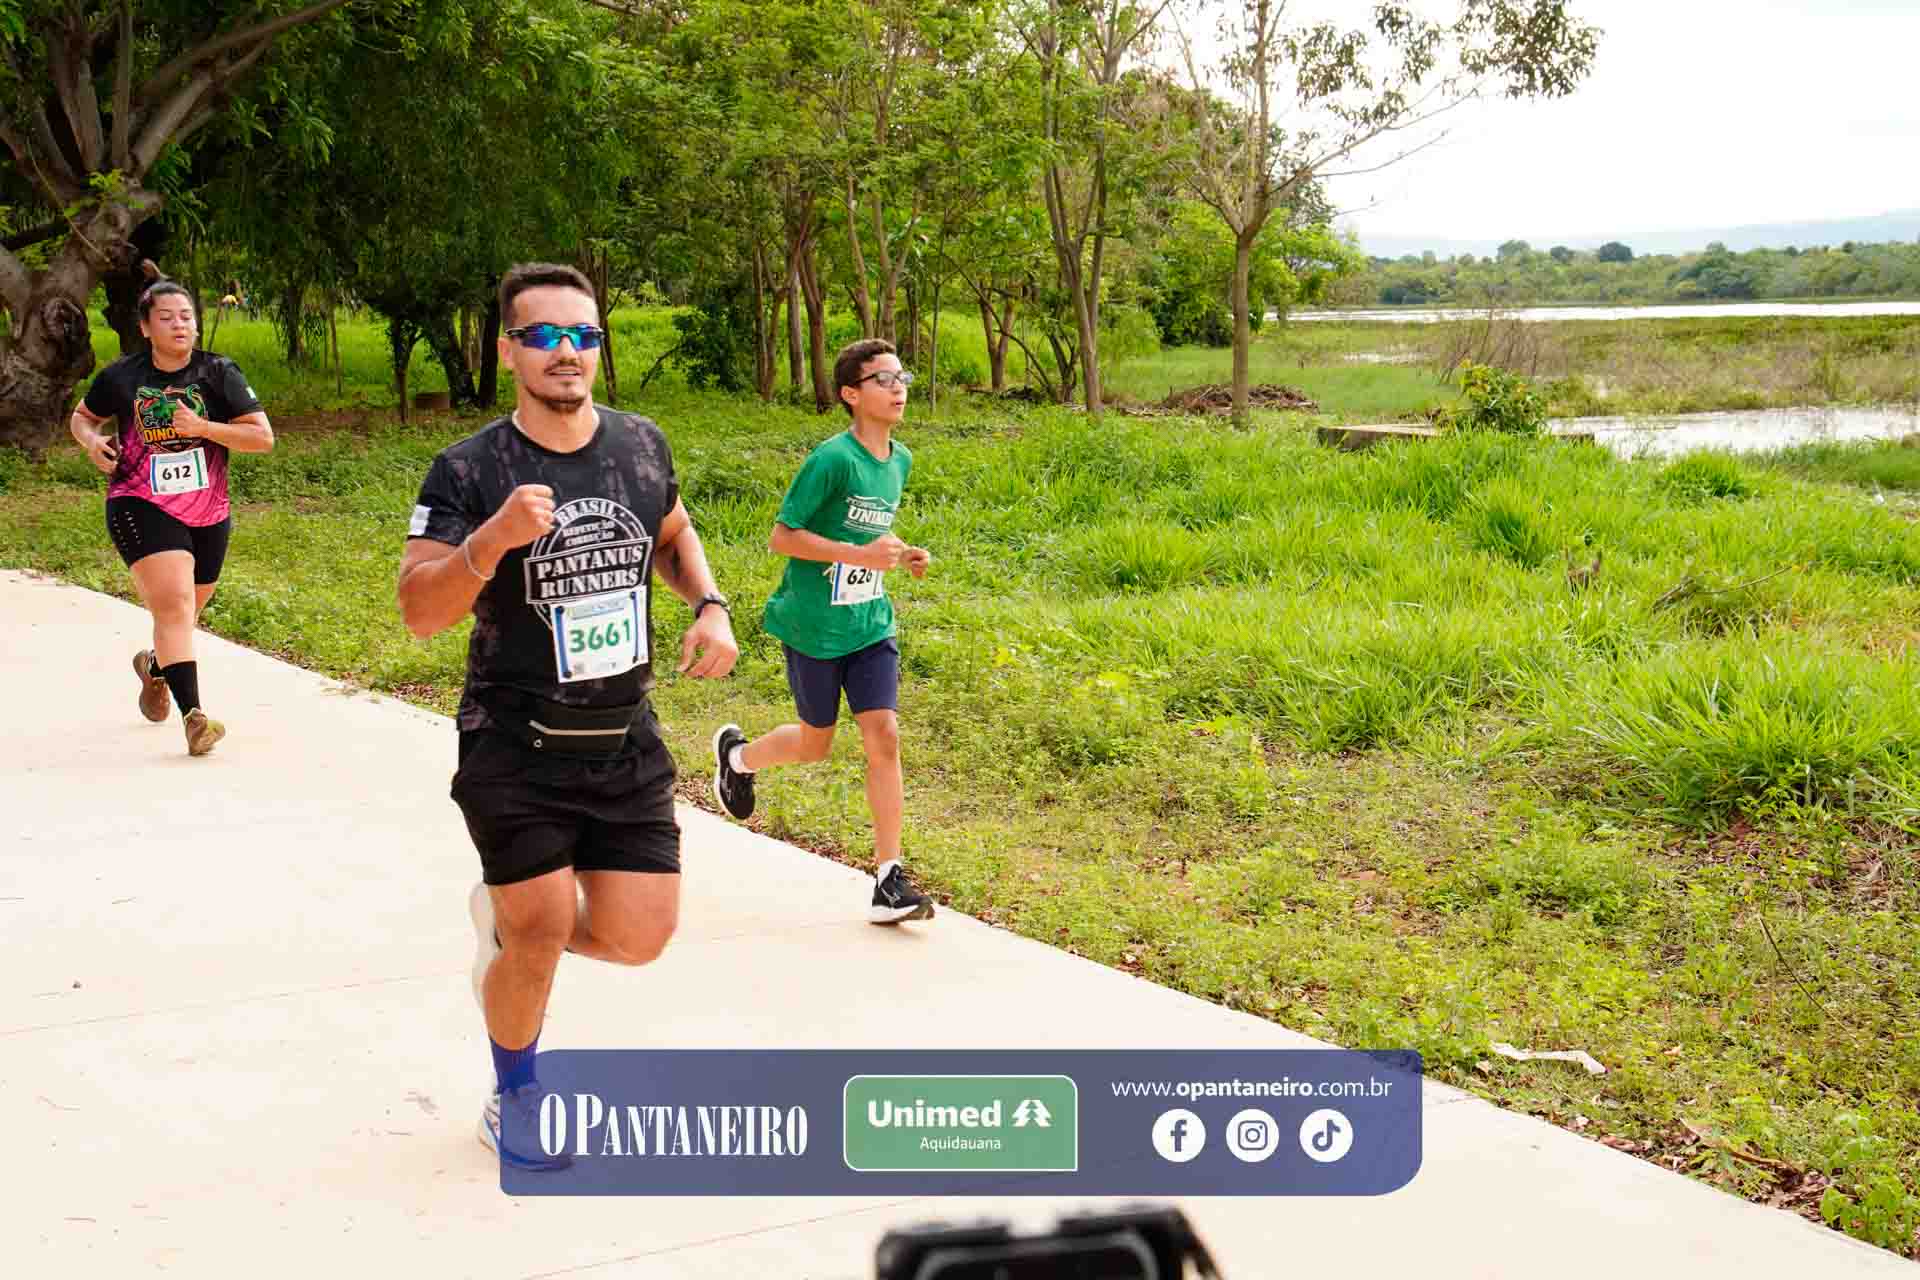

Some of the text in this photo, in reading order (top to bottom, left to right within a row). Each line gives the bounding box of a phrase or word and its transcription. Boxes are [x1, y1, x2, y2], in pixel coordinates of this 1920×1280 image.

[162, 465, 191, 481] 612
[555, 500, 617, 526] BRASIL
[536, 545, 643, 580] PANTANUS
[540, 567, 639, 599] RUNNERS
[569, 618, 630, 653] 3661
